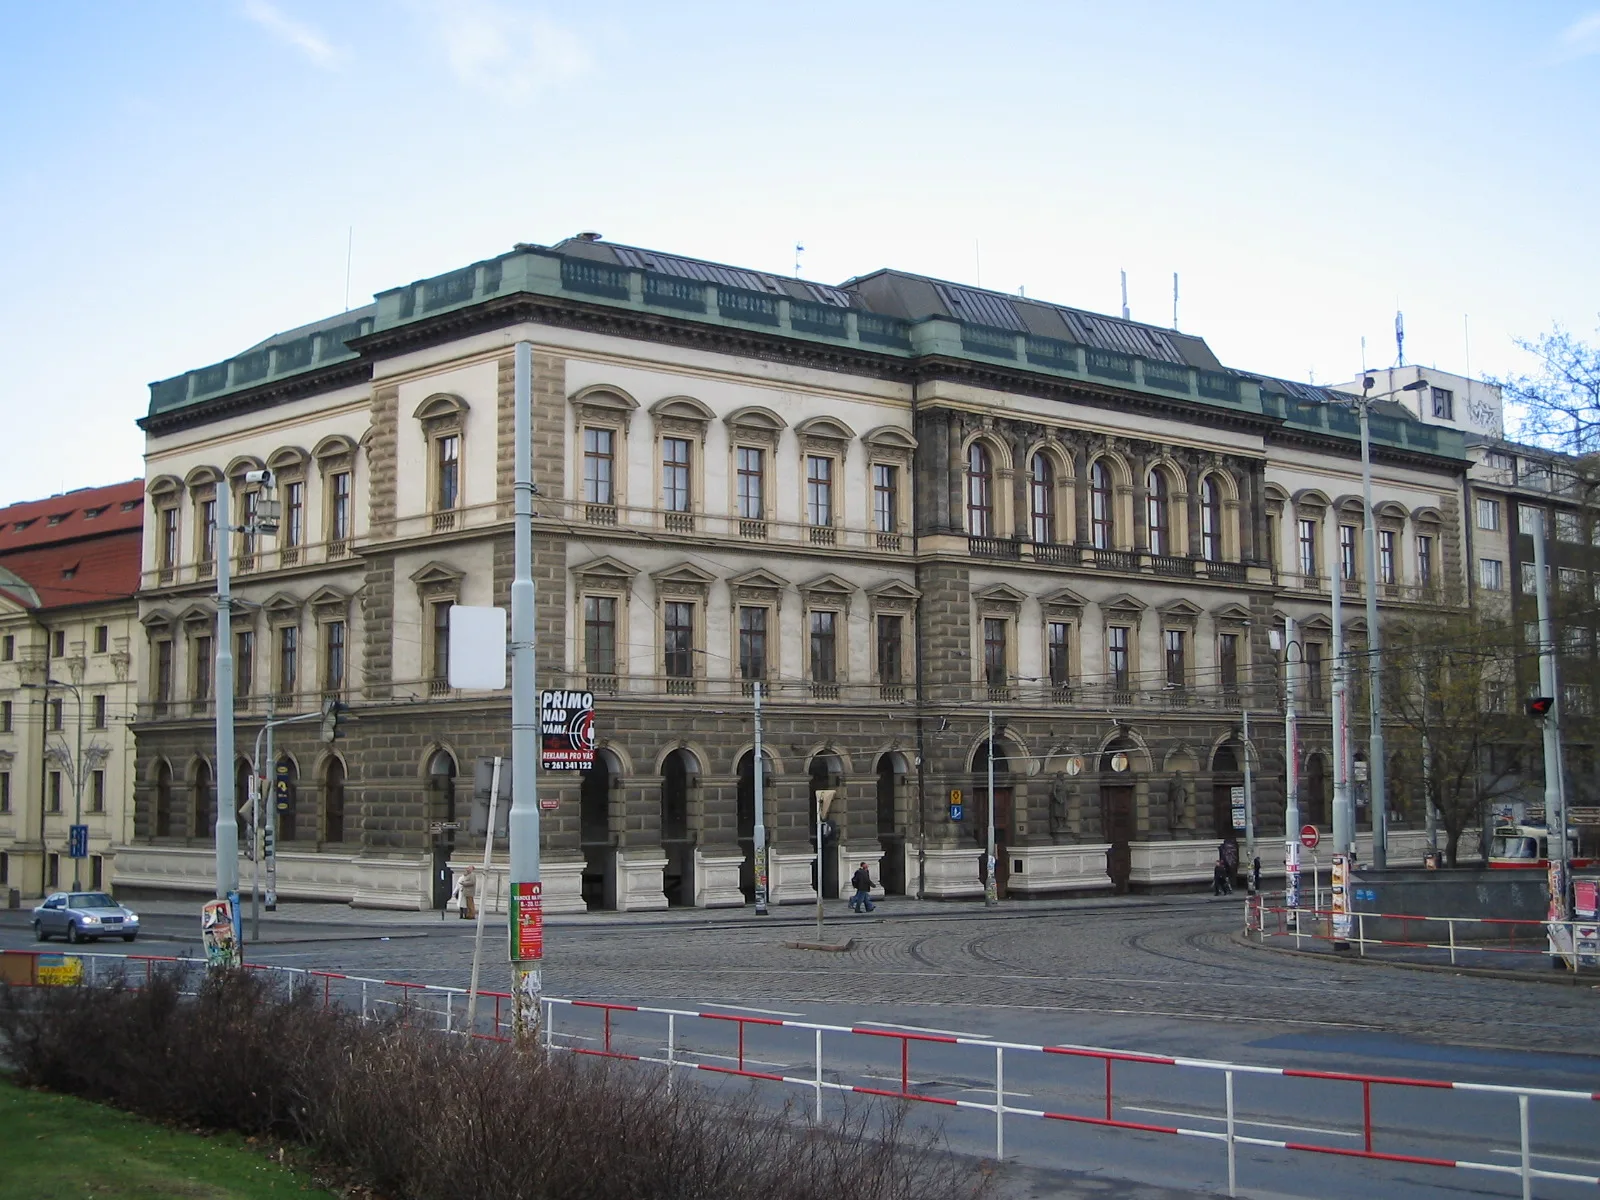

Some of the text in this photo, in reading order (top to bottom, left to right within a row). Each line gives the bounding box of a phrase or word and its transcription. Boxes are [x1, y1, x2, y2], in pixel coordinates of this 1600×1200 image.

[542, 690, 593, 708] PŘÍMO
[543, 709, 567, 722] NAD
[543, 750, 594, 760] REKLAMA PRO VÁS
[551, 761, 592, 769] 261 341 122
